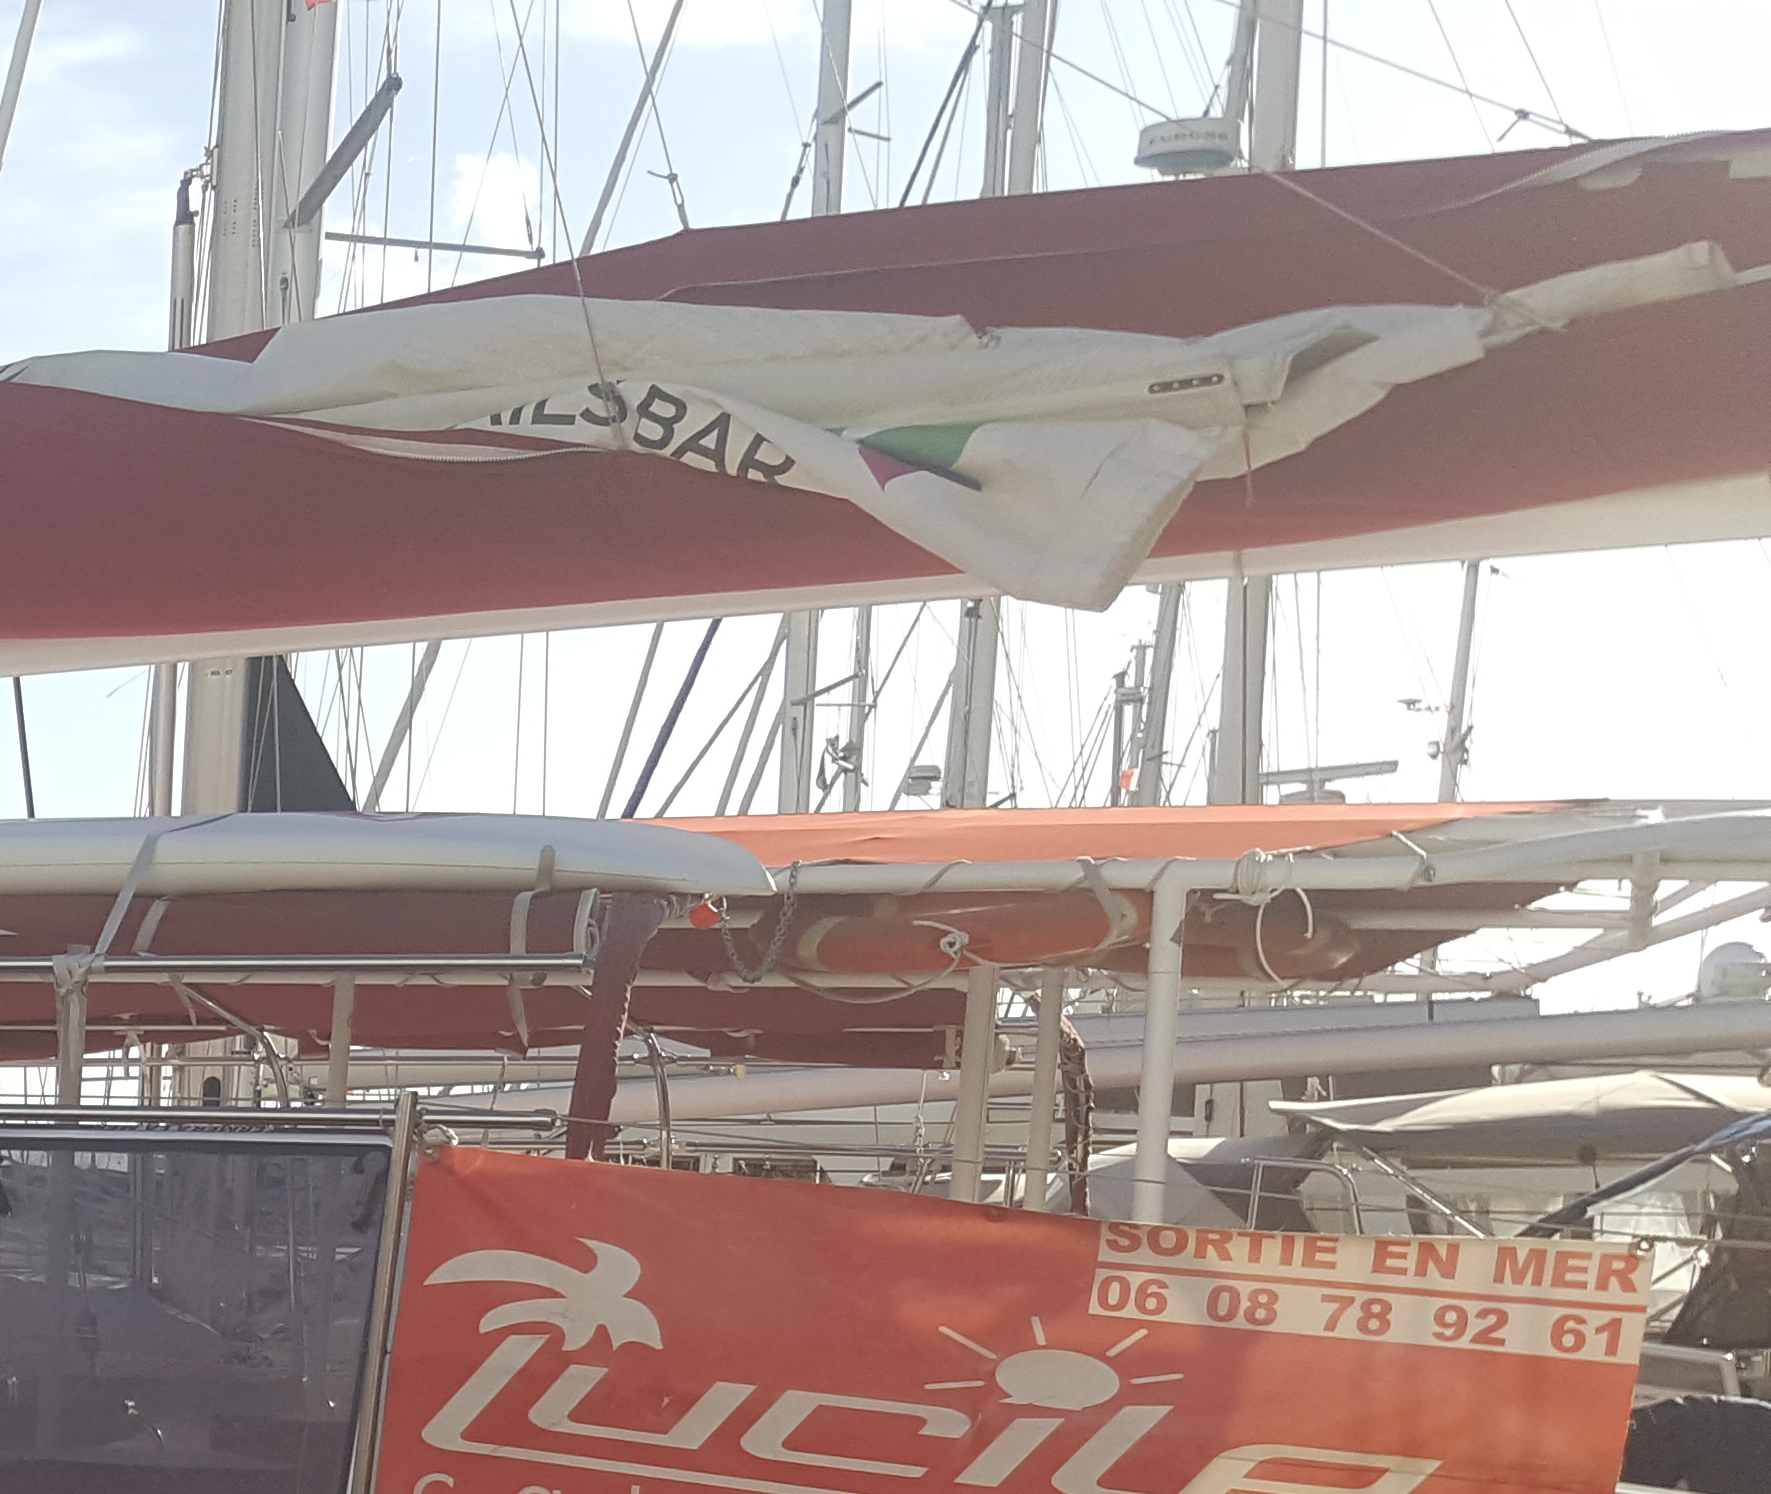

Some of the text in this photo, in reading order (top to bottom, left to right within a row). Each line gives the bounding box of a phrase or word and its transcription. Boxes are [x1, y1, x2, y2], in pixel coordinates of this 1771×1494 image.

[1105, 1222, 1641, 1294] SORTIE EN MER
[1096, 1275, 1625, 1358] 06 08 78 92 61
